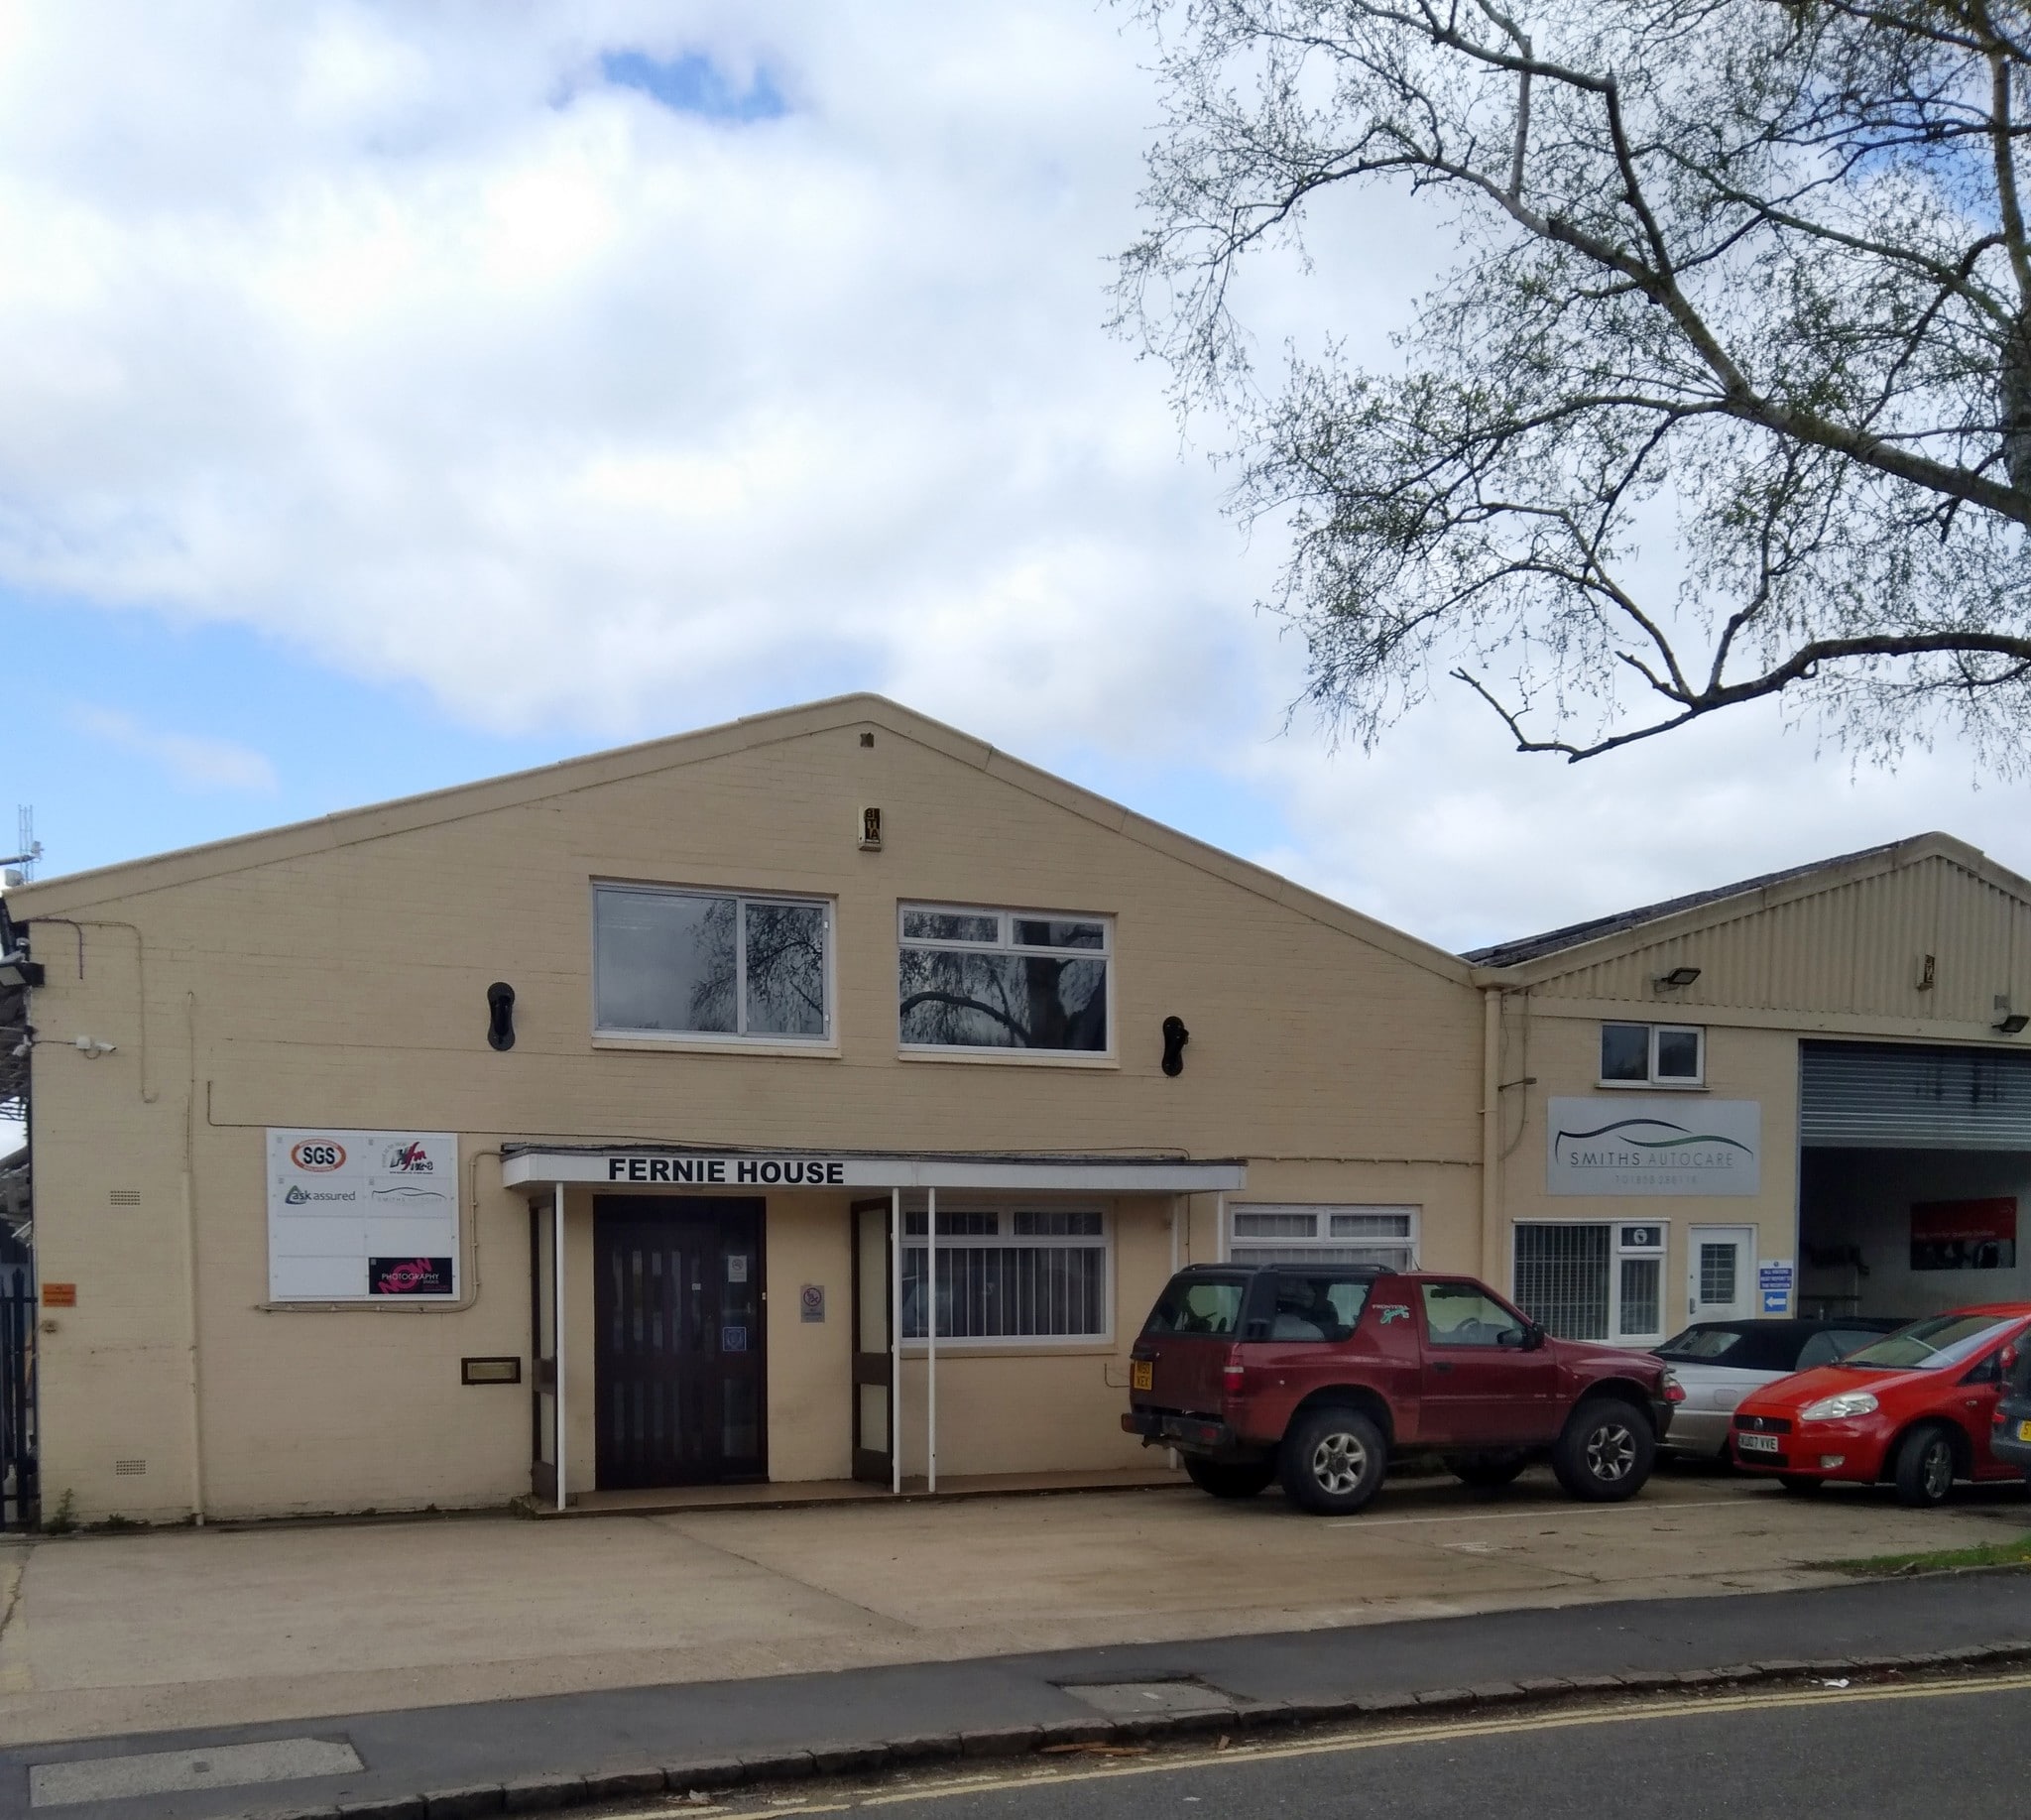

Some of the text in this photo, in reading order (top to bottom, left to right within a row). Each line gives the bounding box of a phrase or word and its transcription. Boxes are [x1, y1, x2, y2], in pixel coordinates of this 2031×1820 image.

[302, 1147, 335, 1164] SGS
[1570, 1152, 1733, 1166] SMITHS AUTOCARE
[608, 1157, 844, 1184] FERNIE HOUSE
[312, 1190, 356, 1201] assured
[381, 1272, 440, 1281] PHOTOGRAPHY
